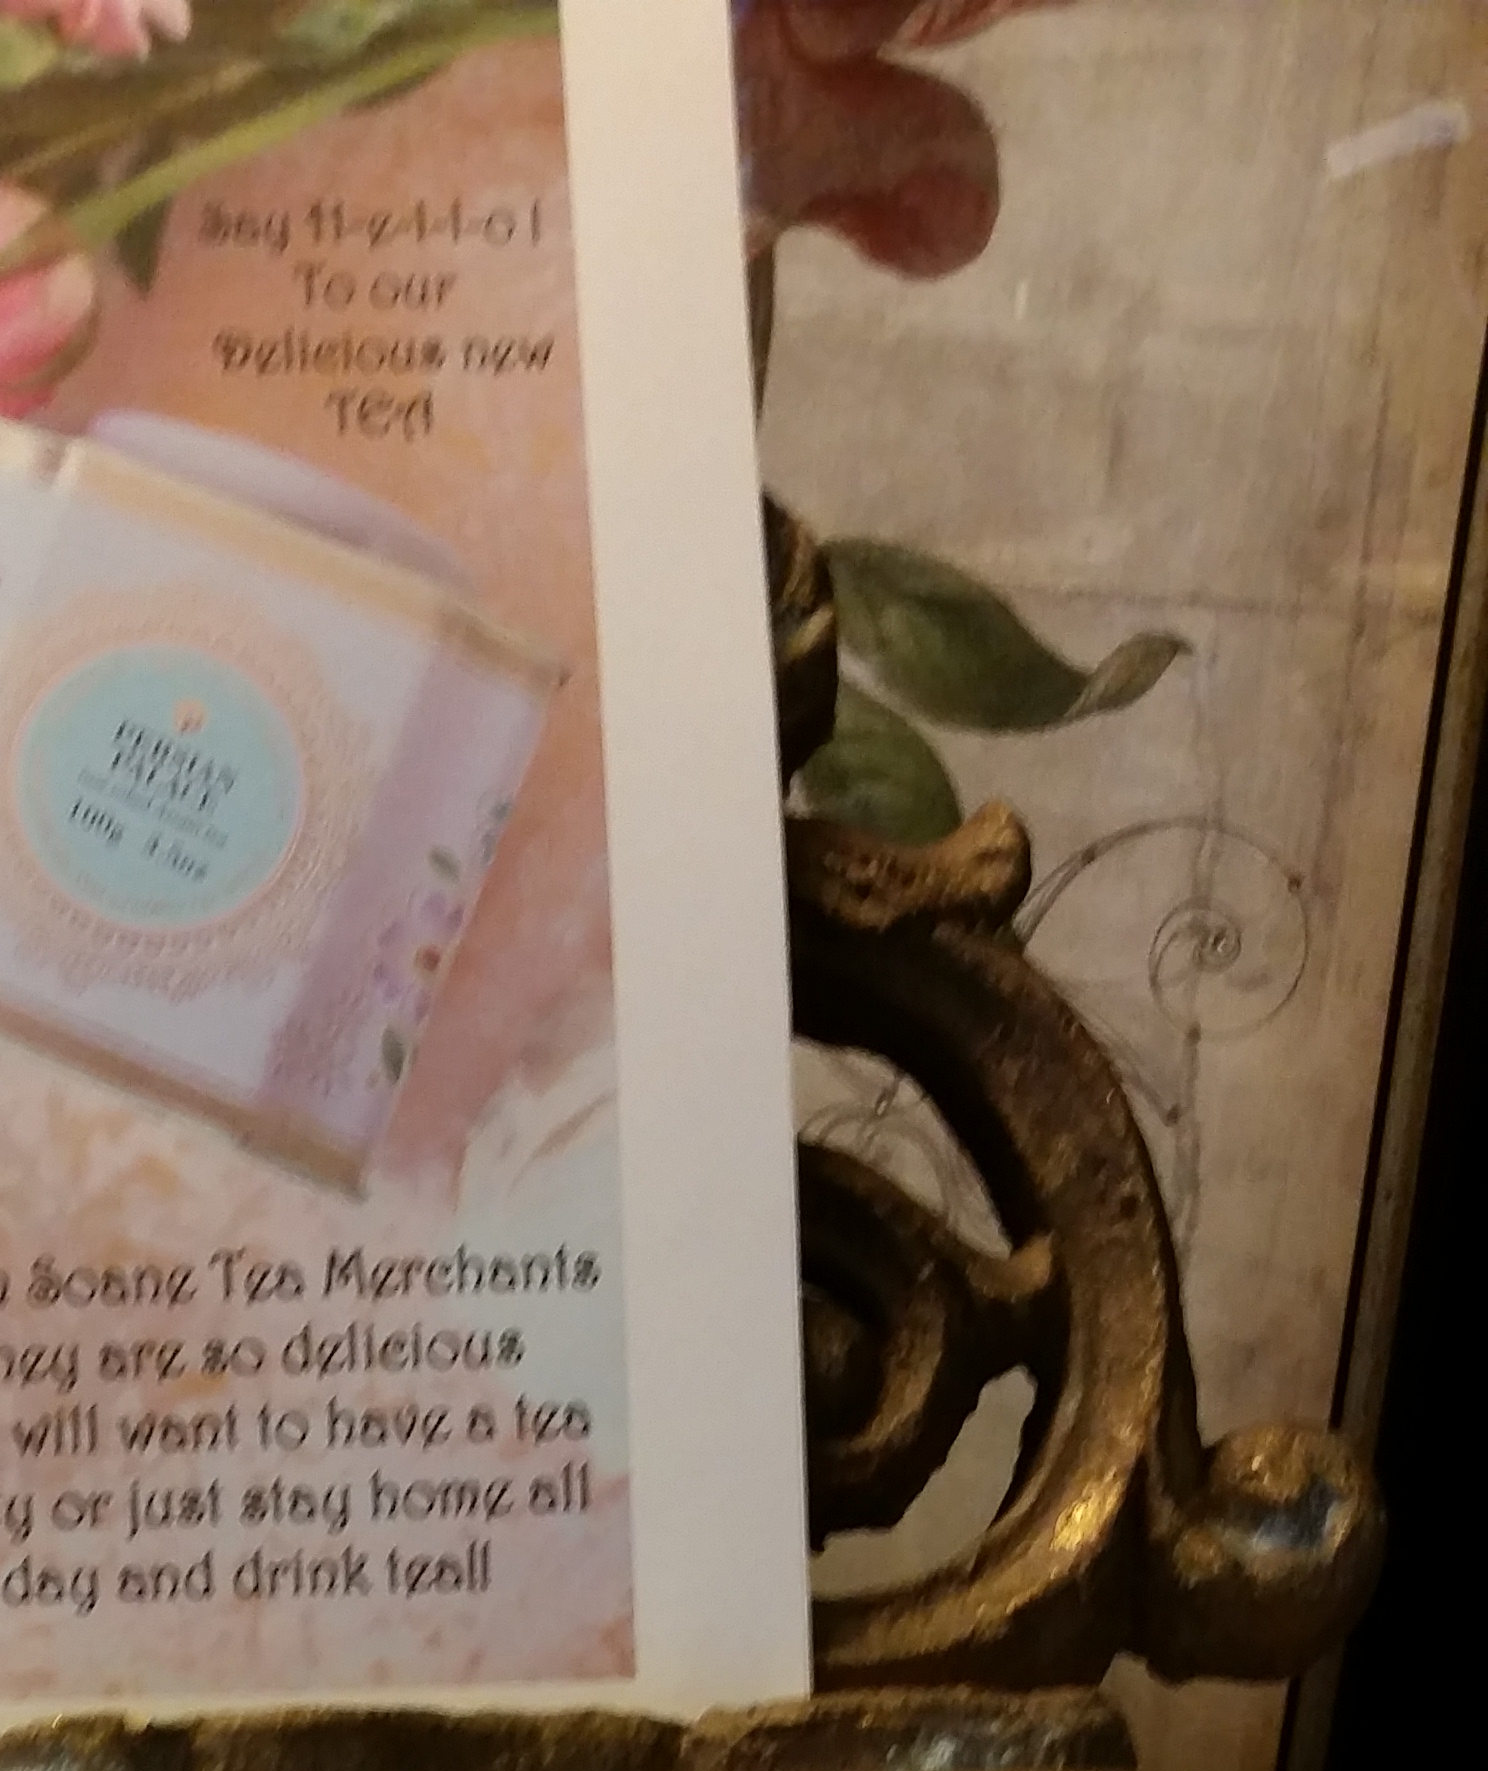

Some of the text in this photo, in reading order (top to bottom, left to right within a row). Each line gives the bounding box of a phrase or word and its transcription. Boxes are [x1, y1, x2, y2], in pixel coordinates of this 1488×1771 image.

[200, 203, 290, 255] Say
[294, 261, 457, 312] To our
[214, 327, 554, 376] Delicious new
[26, 1252, 197, 1311] Soane
[208, 1246, 306, 1308] Tea
[320, 1242, 603, 1301] Merchants
[98, 1338, 187, 1384] are
[201, 1335, 267, 1378] so
[280, 1321, 527, 1381] delicious
[13, 1402, 98, 1455] will
[117, 1402, 239, 1454] want
[257, 1401, 309, 1451] to
[324, 1395, 453, 1449] have
[466, 1402, 497, 1443] a
[514, 1392, 592, 1447] tea
[50, 1489, 114, 1532] or
[126, 1477, 221, 1543] just
[239, 1475, 352, 1535] stay
[369, 1467, 514, 1522] home
[528, 1458, 590, 1515] all
[1, 1554, 99, 1618] day
[116, 1548, 214, 1602] and
[231, 1545, 373, 1599] drink
